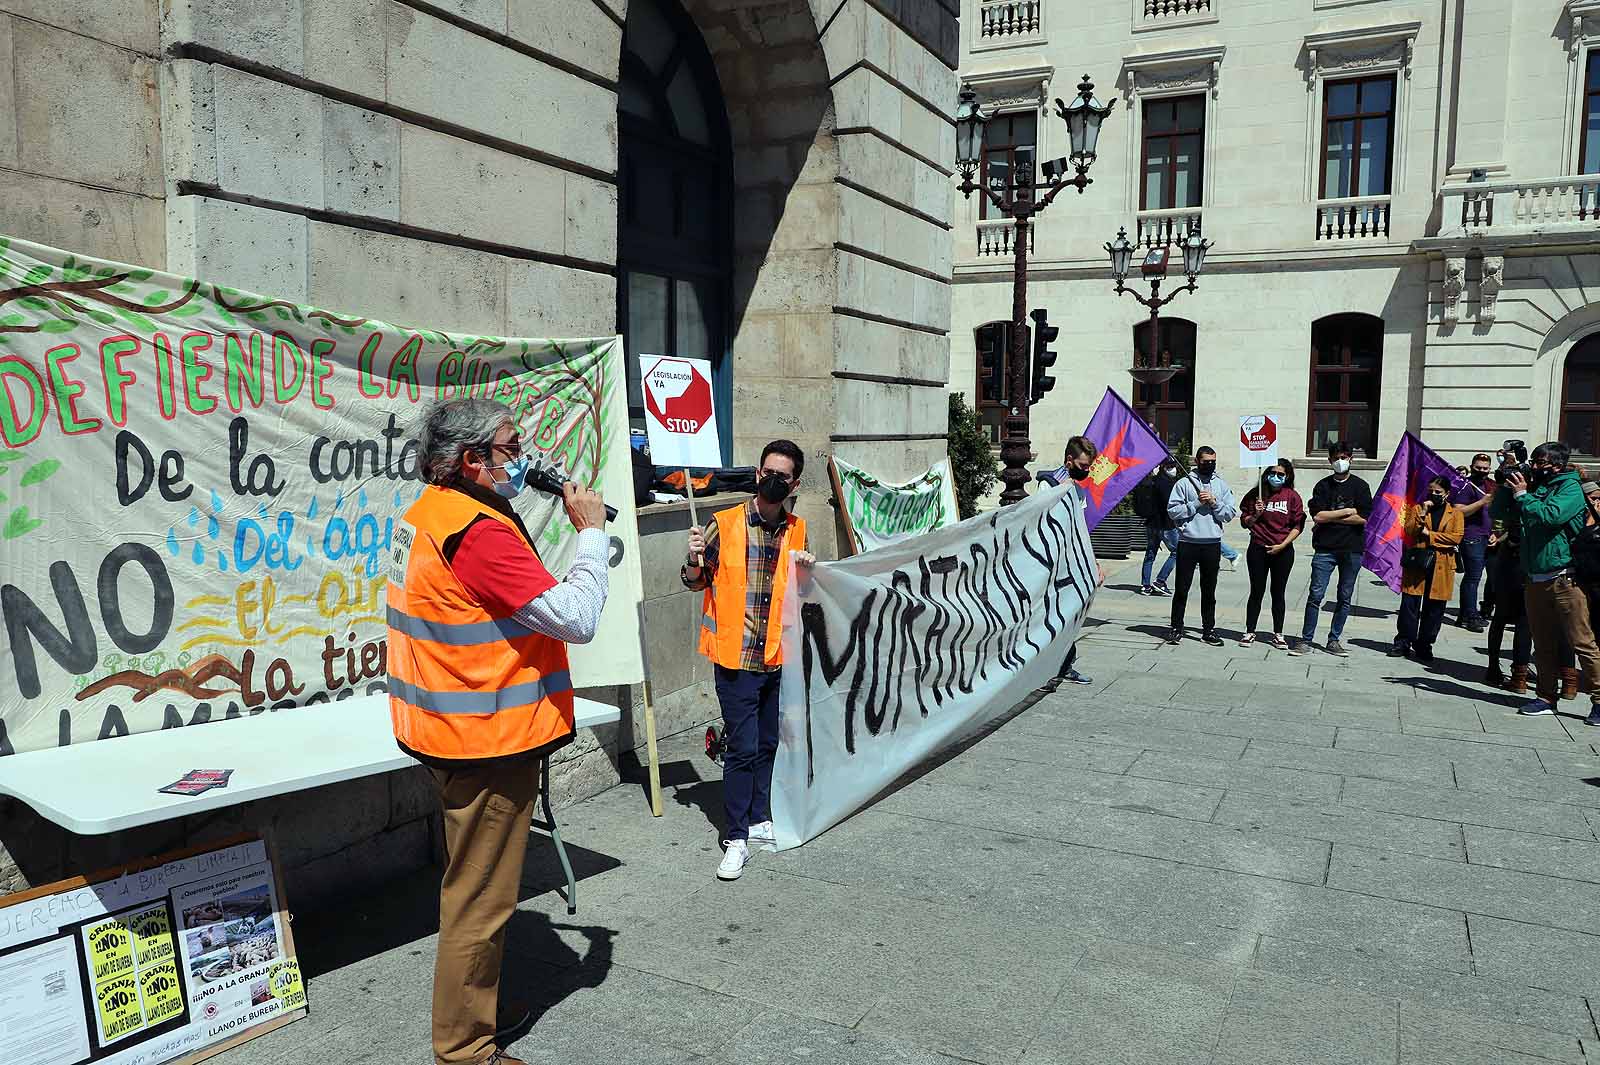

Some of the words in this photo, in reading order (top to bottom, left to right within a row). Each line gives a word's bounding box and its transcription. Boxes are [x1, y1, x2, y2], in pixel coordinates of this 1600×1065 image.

[0, 330, 337, 449] DEFIENDE
[358, 331, 423, 403] LA
[654, 380, 665, 388] YA
[666, 418, 698, 433] STOP
[114, 429, 194, 507] De
[229, 415, 287, 497] la
[234, 511, 301, 573] Del
[317, 565, 388, 618] air
[0, 542, 175, 700] NO
[131, 909, 167, 928] GRANJA
[89, 921, 127, 941] GRANJA
[148, 938, 158, 947] EN
[105, 951, 117, 960] EN
[138, 948, 153, 966] LLANO
[152, 946, 159, 961] DE
[159, 941, 173, 959] BUREBA
[96, 960, 111, 979] LLANO
[110, 958, 117, 974] DE
[117, 954, 134, 972] BUREBA
[140, 965, 175, 986] GRANJA
[98, 979, 136, 1001] GRANJA
[217, 984, 224, 992] A
[225, 979, 237, 989] LA
[238, 966, 271, 984] GRANJA
[146, 1003, 160, 1022] LLANO
[160, 1002, 167, 1017] DE
[166, 996, 182, 1014] BUREBA
[156, 994, 167, 1003] EN
[234, 1000, 244, 1008] EN
[104, 1019, 120, 1038] LLANO
[119, 1017, 126, 1032] DE
[125, 1012, 143, 1031] BUREBA
[115, 1009, 127, 1018] EN
[208, 1020, 236, 1037] LLANO
[237, 1015, 248, 1026] DE
[248, 1002, 280, 1021] BUREBA
